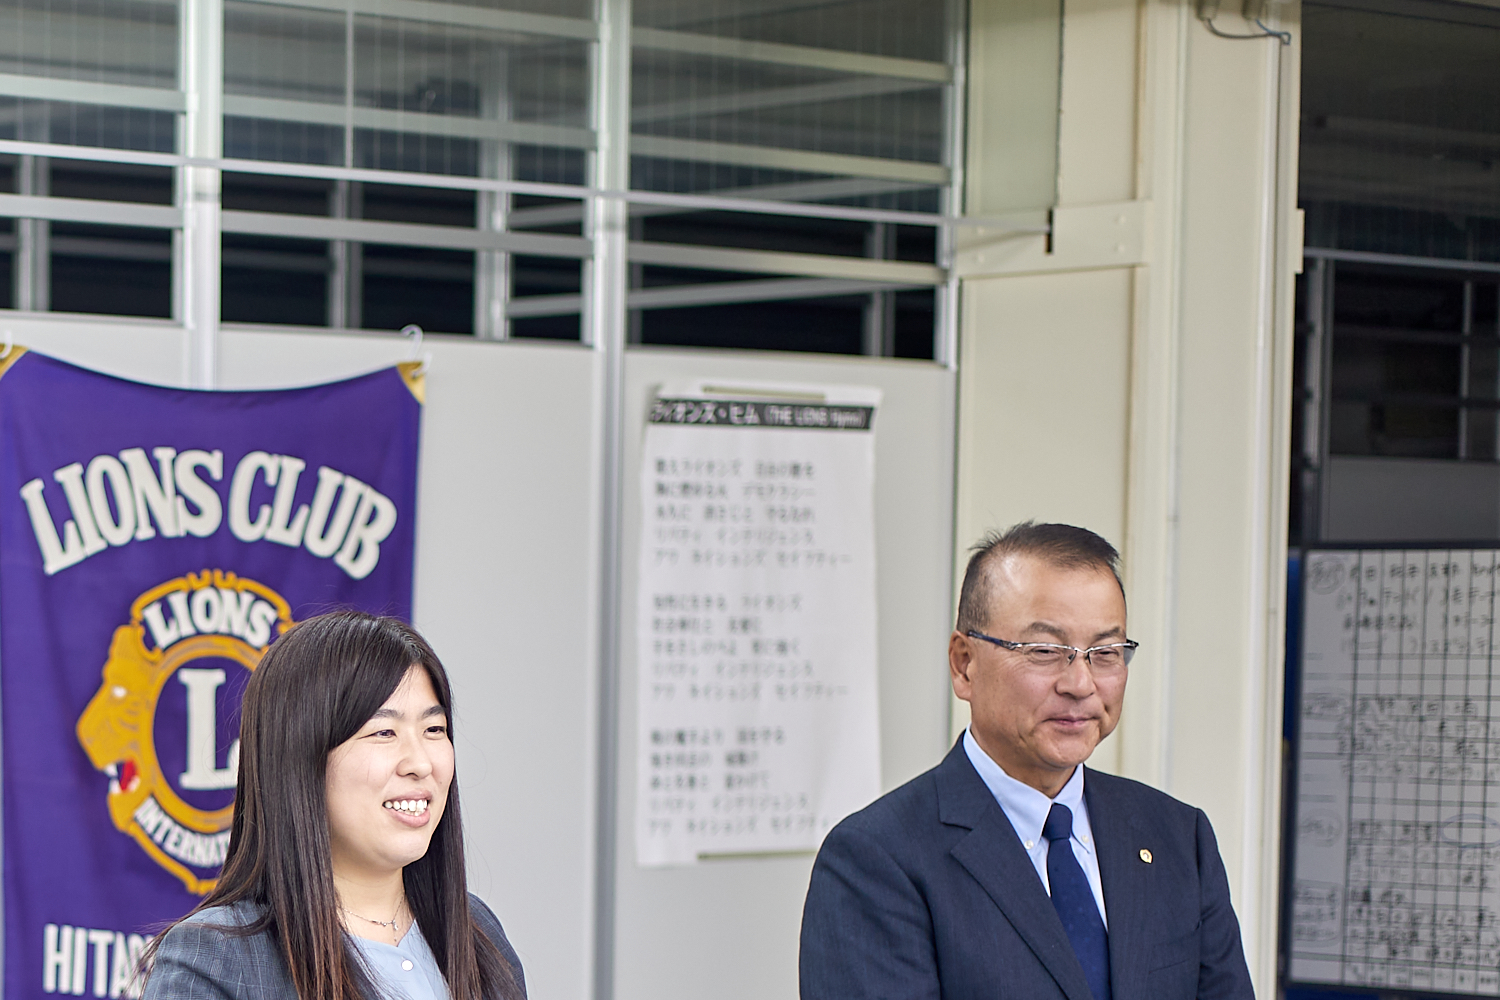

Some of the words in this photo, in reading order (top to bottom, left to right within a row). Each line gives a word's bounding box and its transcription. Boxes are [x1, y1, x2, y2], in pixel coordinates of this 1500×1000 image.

[20, 447, 223, 575] LIONS
[228, 450, 397, 580] CLUB
[143, 586, 278, 649] LIONS
[178, 668, 240, 790] L
[133, 796, 231, 867] INTERNAT
